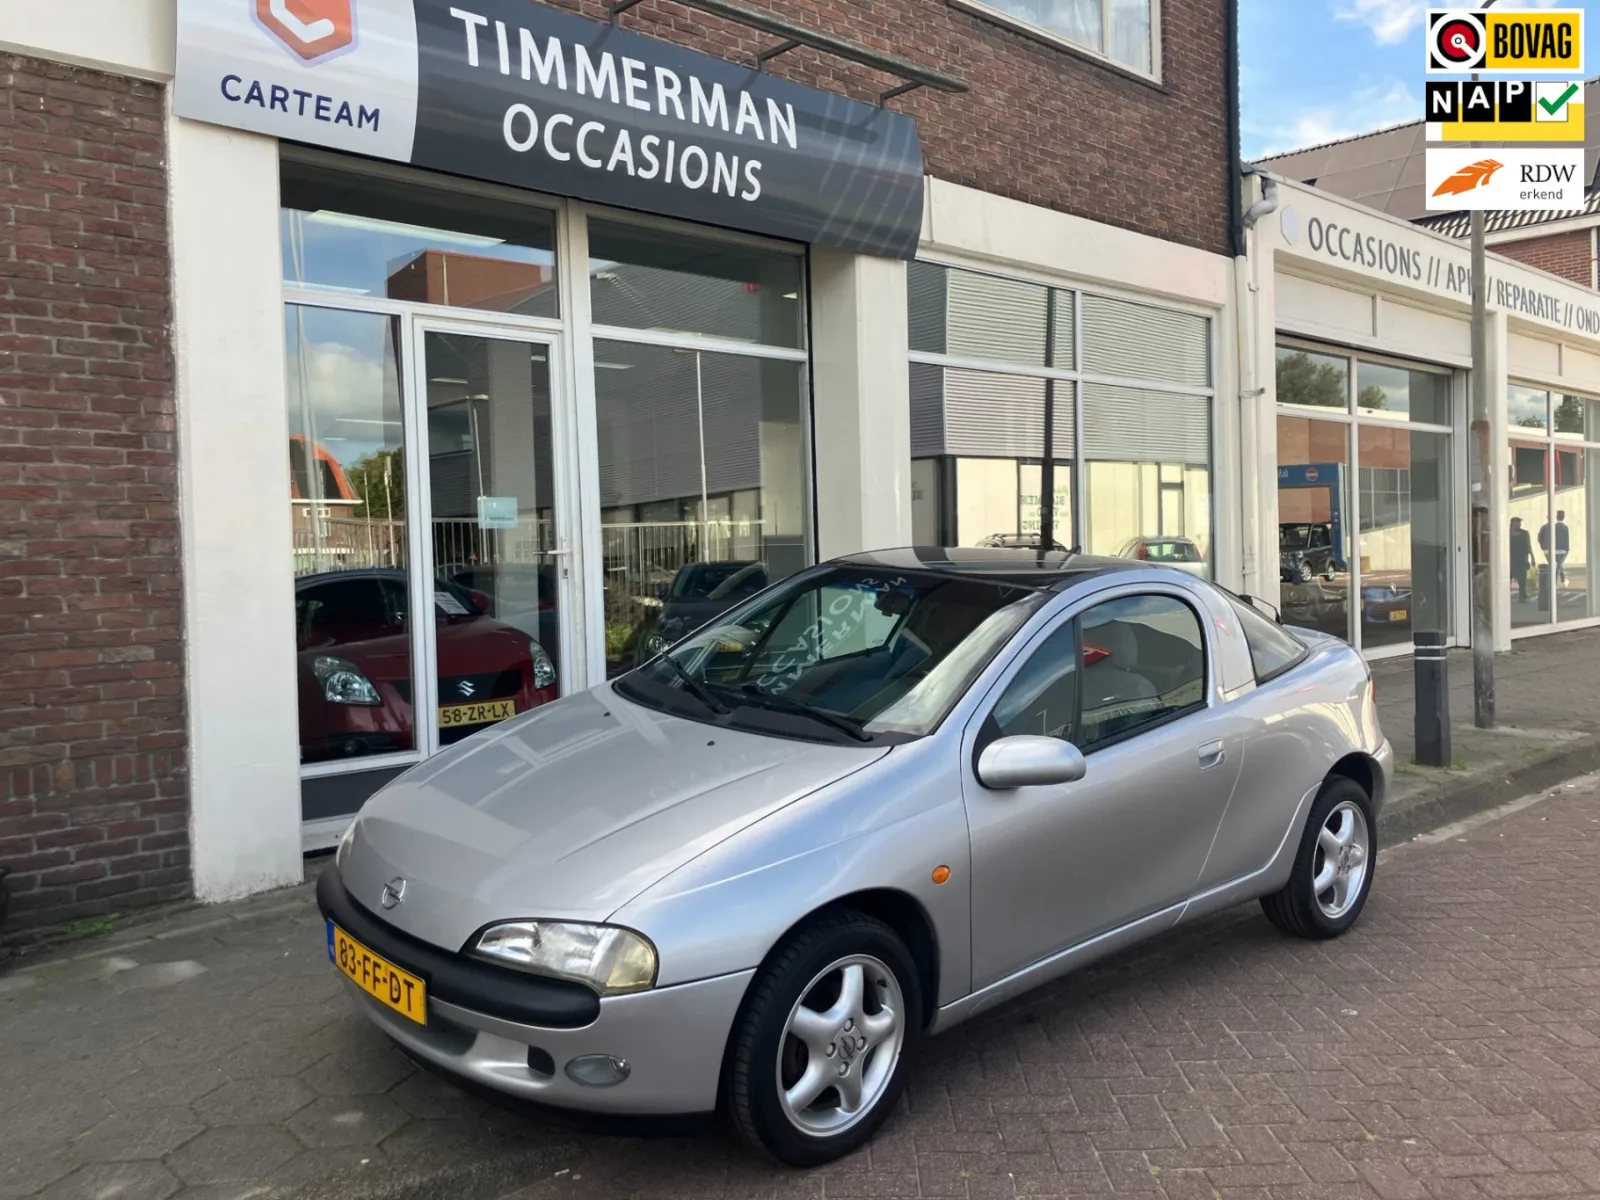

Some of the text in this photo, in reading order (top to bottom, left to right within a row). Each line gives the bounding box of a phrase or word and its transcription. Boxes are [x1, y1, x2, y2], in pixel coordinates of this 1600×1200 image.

[220, 73, 381, 133] CARTEAM
[449, 6, 799, 150] TIMMERMAN
[502, 102, 763, 202] OCCASIONS
[1308, 216, 1422, 282] OCCASIONS
[1496, 278, 1561, 324] REPARATIE
[442, 702, 510, 725] 58-ZR-LX
[339, 937, 415, 1013] 83-FF-DT
